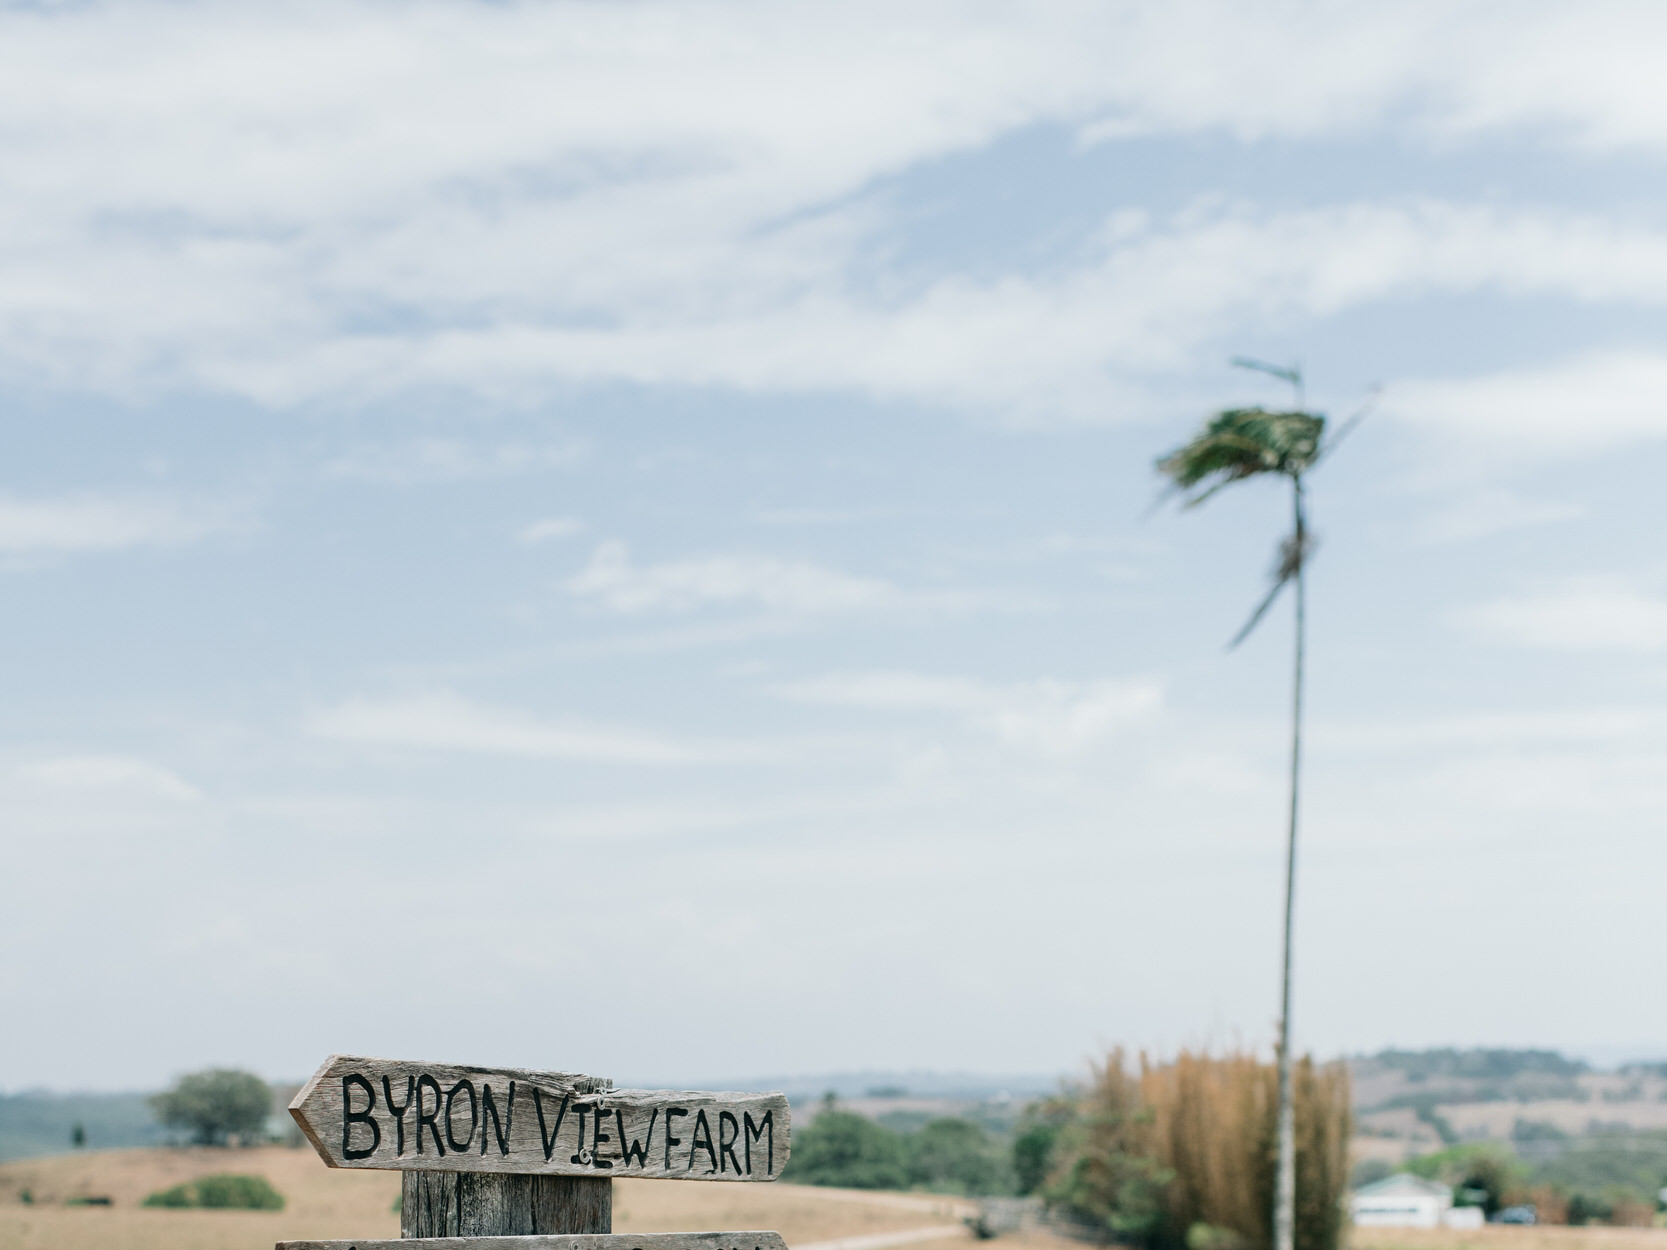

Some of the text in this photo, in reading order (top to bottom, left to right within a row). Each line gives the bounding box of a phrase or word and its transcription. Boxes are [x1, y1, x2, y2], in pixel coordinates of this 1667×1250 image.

[342, 1073, 774, 1176] BYRON VIEW FARM
